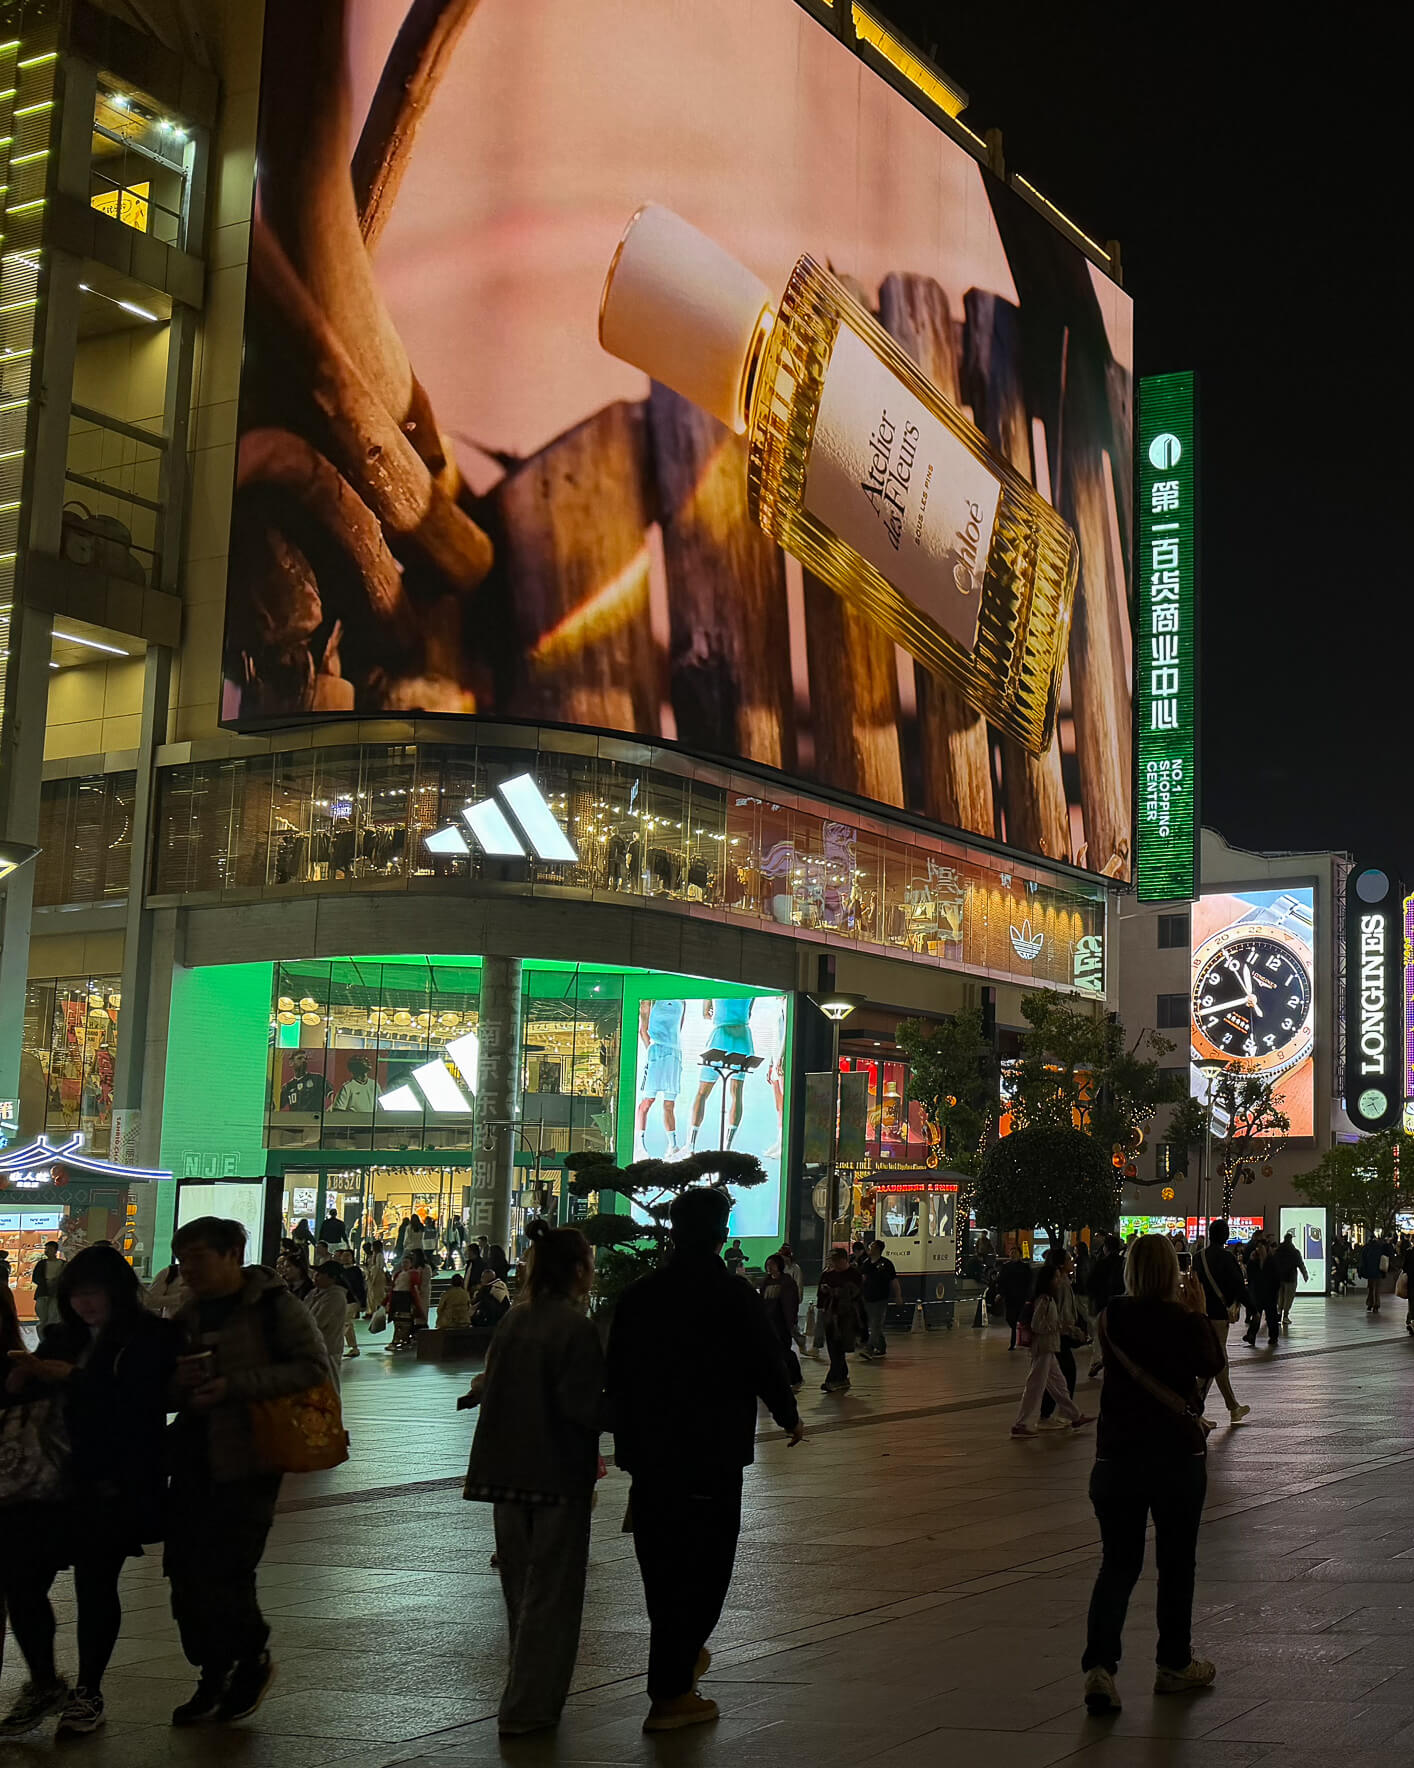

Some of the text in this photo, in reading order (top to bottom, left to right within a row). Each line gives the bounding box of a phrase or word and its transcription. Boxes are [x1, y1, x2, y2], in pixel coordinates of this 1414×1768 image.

[861, 409, 896, 517] Atelier
[883, 420, 920, 551] des Fleurs
[914, 464, 934, 547] SOUS LES PINS
[953, 499, 984, 596] Chloé
[1151, 480, 1180, 730] 第一百货商业中心
[1171, 759, 1183, 792] NO.1
[1147, 762, 1158, 821] CENTER
[1159, 761, 1170, 837] SHOPPING
[1246, 952, 1256, 965] 11
[1265, 956, 1282, 972] 12
[1208, 973, 1220, 986] 9
[1285, 974, 1294, 987] 1
[1203, 995, 1214, 1008] 8
[1288, 996, 1299, 1008] 2
[1361, 914, 1385, 1075] LONGINES
[1208, 1016, 1219, 1029] 7
[1282, 1019, 1294, 1031] 3
[1263, 1034, 1275, 1046] 4
